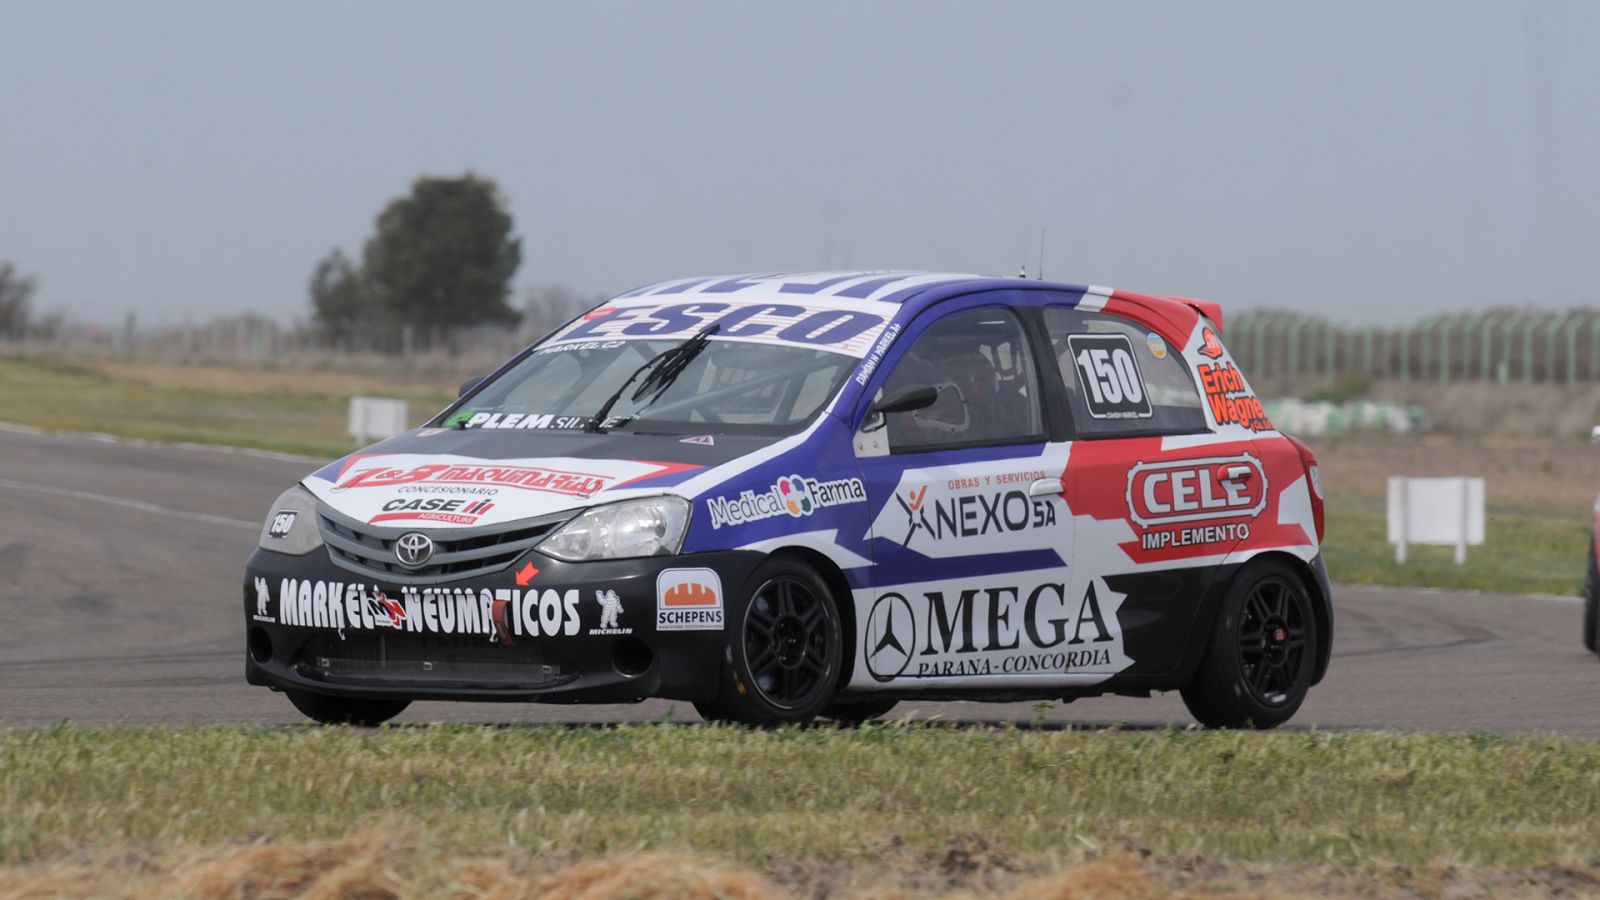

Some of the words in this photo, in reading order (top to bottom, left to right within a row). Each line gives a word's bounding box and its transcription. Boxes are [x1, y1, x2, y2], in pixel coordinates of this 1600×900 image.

[1077, 349, 1142, 404] 150
[1198, 361, 1244, 394] Erich
[398, 486, 498, 496] CONCESIONARIO
[948, 478, 980, 490] OBRAS
[984, 475, 991, 486] Y
[996, 470, 1046, 485] SERVICIOS
[1143, 466, 1251, 514] CELE
[382, 499, 465, 512] CASE
[709, 487, 785, 525] Medical
[807, 480, 864, 504] Farma
[936, 490, 1029, 540] NEXO
[1033, 500, 1056, 528] SA
[271, 513, 295, 534] 150
[418, 512, 474, 523] AGRICULTURE
[1142, 523, 1249, 550] IMPLEMENTO
[658, 610, 722, 624] SCHEPENS
[920, 579, 1114, 655] MEGA
